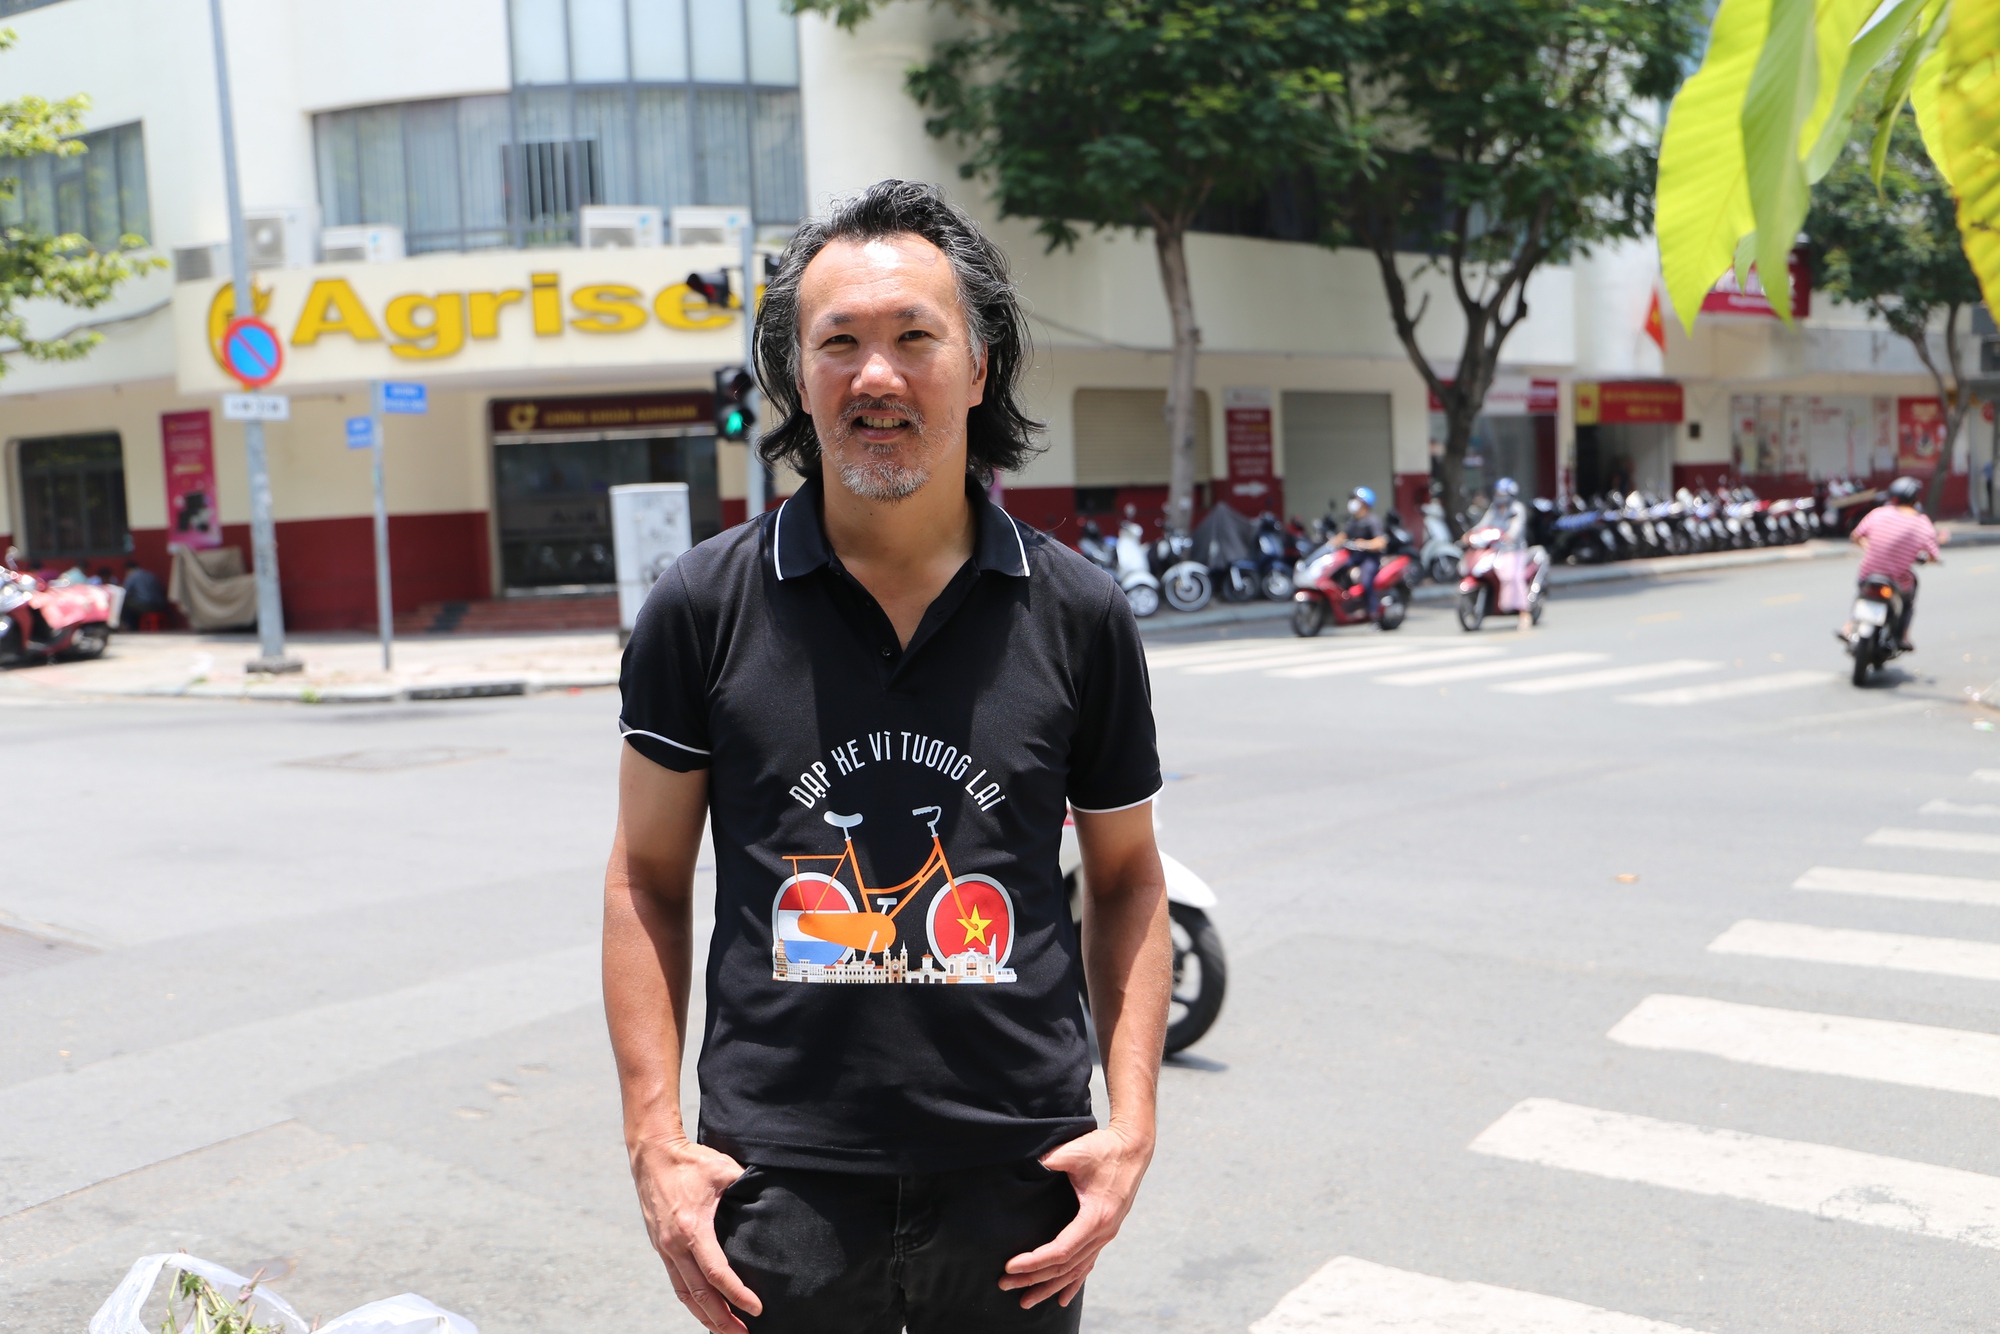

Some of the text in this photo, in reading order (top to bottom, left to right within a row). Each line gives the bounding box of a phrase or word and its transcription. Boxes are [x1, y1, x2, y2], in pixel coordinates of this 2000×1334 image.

[290, 272, 767, 360] Agrise
[830, 738, 866, 776] XE
[900, 731, 972, 780] TƯƠNG
